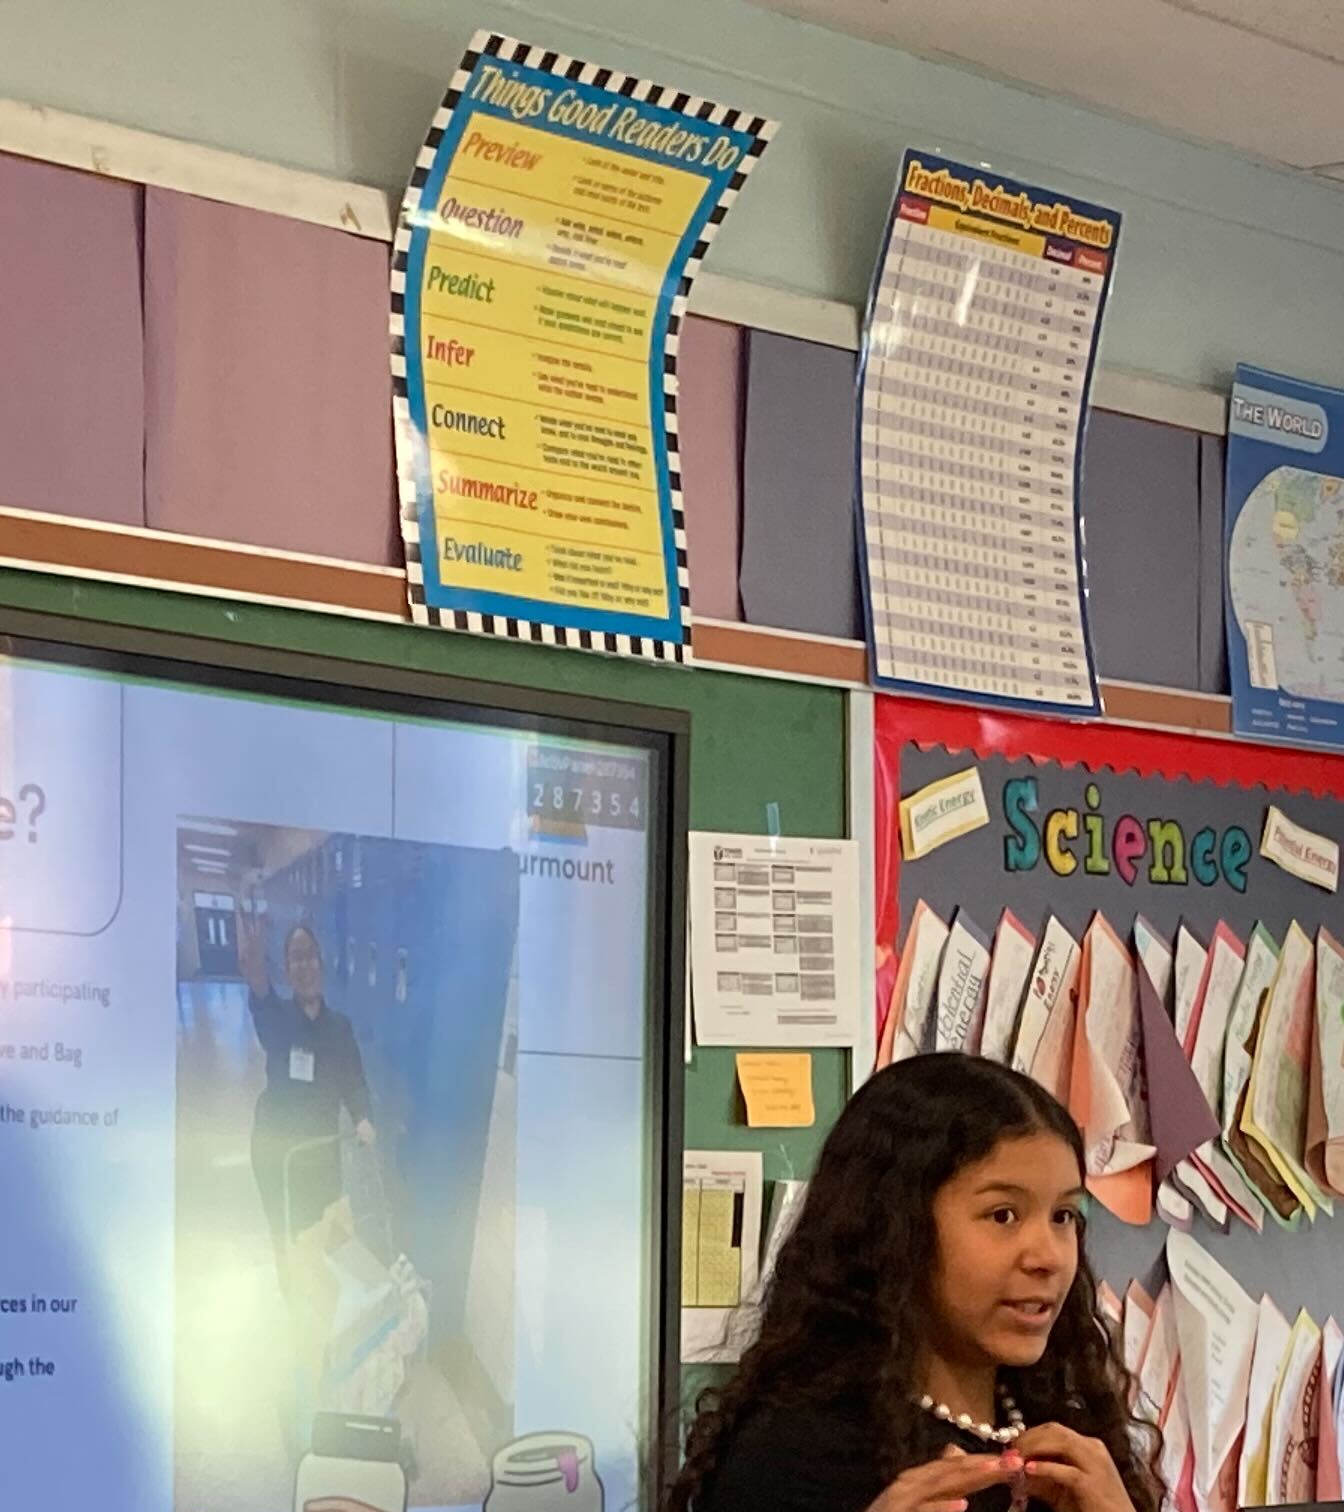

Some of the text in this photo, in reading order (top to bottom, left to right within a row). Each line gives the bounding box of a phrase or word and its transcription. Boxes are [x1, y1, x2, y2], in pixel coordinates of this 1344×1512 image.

[471, 64, 553, 120] Things
[548, 90, 613, 142] Good
[609, 109, 709, 163] Readers
[702, 135, 740, 172] Do
[462, 131, 543, 172] Preview
[905, 160, 969, 212] Fractions,
[971, 179, 1033, 228] Decimals,
[1032, 202, 1056, 229] and
[440, 197, 524, 239] Question
[427, 266, 495, 304] Predict
[427, 335, 475, 368] Infer
[432, 403, 506, 441] Connect
[437, 469, 538, 511] Summarize
[444, 537, 523, 572] Evaluate
[1002, 775, 1253, 893] Science
[13, 978, 112, 1008] participating
[20, 1041, 49, 1062] and
[53, 1042, 83, 1067] Bag
[0, 1102, 26, 1124] the
[29, 1104, 100, 1129] guidance
[103, 1107, 120, 1128] of
[31, 1294, 46, 1313] in
[50, 1297, 78, 1313] our
[29, 1357, 55, 1377] the
